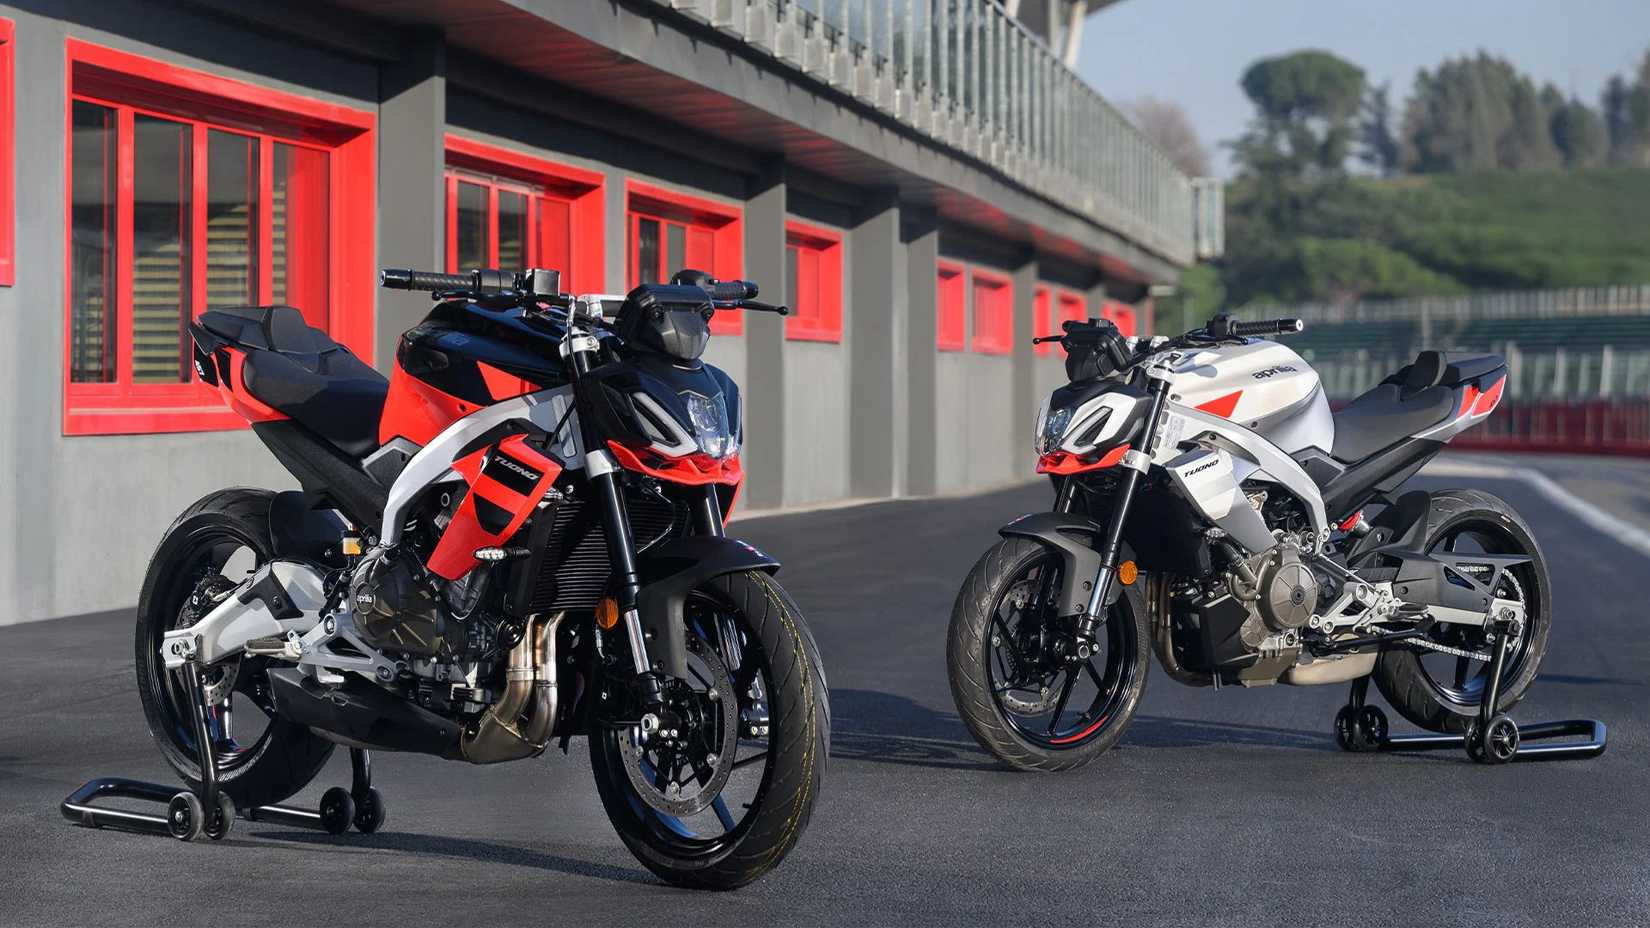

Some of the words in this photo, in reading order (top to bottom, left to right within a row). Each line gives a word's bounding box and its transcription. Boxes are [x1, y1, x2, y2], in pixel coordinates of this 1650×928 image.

[1252, 365, 1297, 379] aprilia
[494, 455, 539, 480] TUONO
[1184, 459, 1219, 478] TUONO
[356, 594, 373, 604] aprilia
